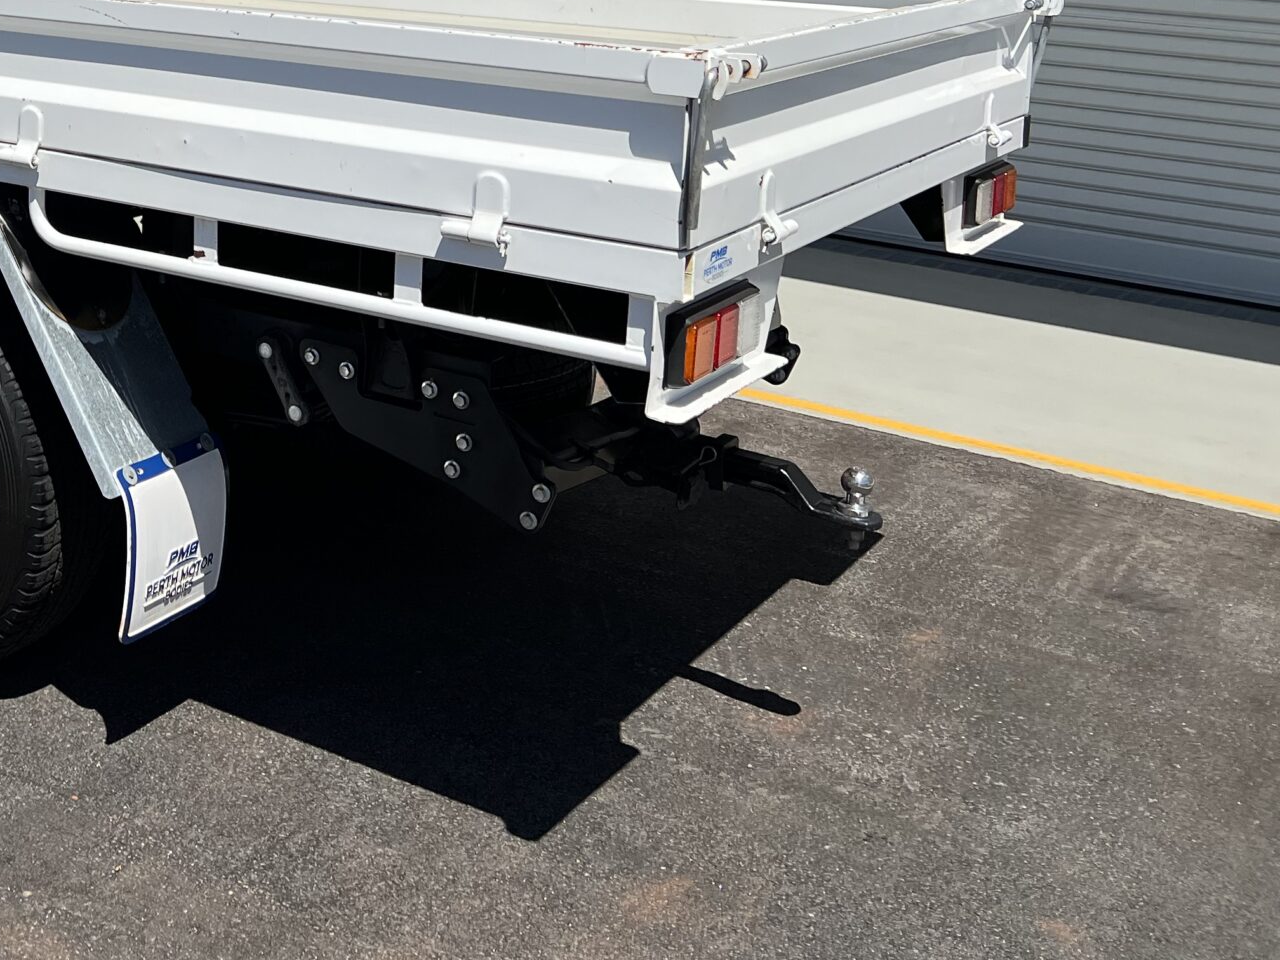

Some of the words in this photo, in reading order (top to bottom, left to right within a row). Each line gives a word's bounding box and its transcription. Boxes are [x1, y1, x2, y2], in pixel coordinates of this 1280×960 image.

[710, 245, 728, 261] PMB
[703, 265, 718, 278] PERTH
[717, 257, 733, 272] MOTOR
[167, 540, 199, 568] PMB
[145, 570, 179, 602] PERTH
[180, 552, 214, 581] MOTOR
